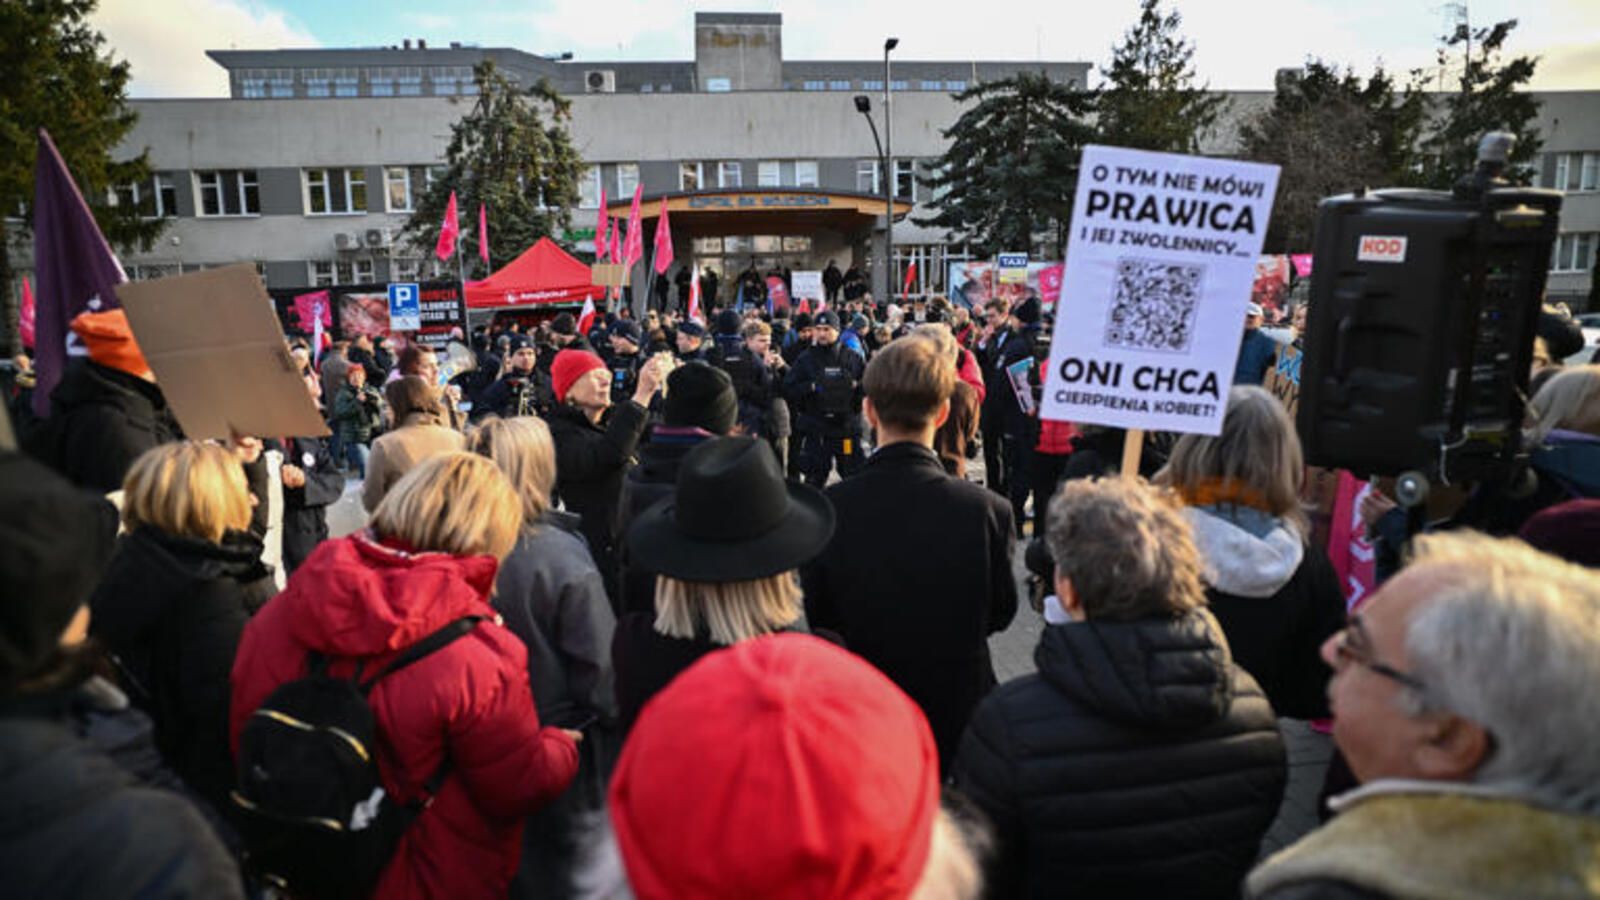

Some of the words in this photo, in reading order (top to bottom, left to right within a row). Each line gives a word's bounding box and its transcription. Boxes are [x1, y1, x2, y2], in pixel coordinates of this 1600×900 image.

[1092, 164, 1108, 182] O
[1115, 167, 1158, 186] TYM
[1163, 172, 1197, 191] NIE
[1202, 174, 1264, 199] MÓWI
[1085, 189, 1255, 234] PRAWICA
[1080, 226, 1087, 241] I
[1091, 227, 1115, 244] JEJ
[1362, 239, 1401, 254] KOD
[395, 287, 411, 307] P
[1060, 357, 1123, 388] ONI
[1055, 389, 1150, 413] CIERPIENIA
